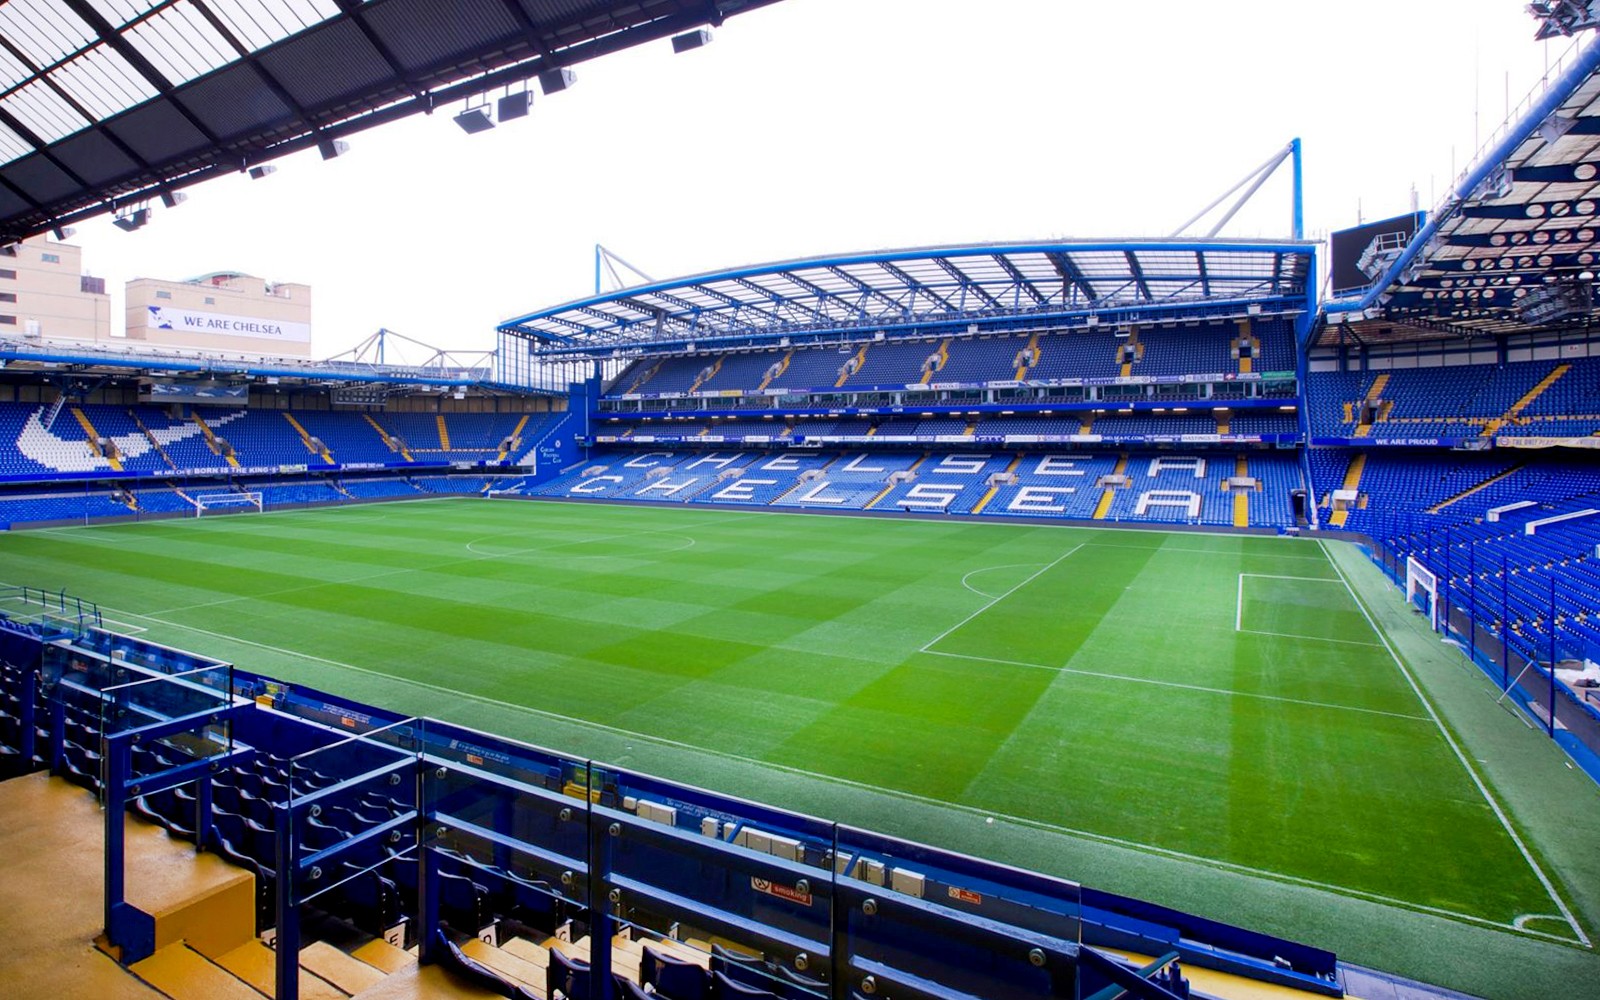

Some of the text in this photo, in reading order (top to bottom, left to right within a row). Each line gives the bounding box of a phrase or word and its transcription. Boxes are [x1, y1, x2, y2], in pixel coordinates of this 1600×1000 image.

[184, 316, 282, 335] WE ARE CHELSEA
[624, 452, 1206, 477] CHELSEA
[570, 475, 1200, 517] CHELSEA
